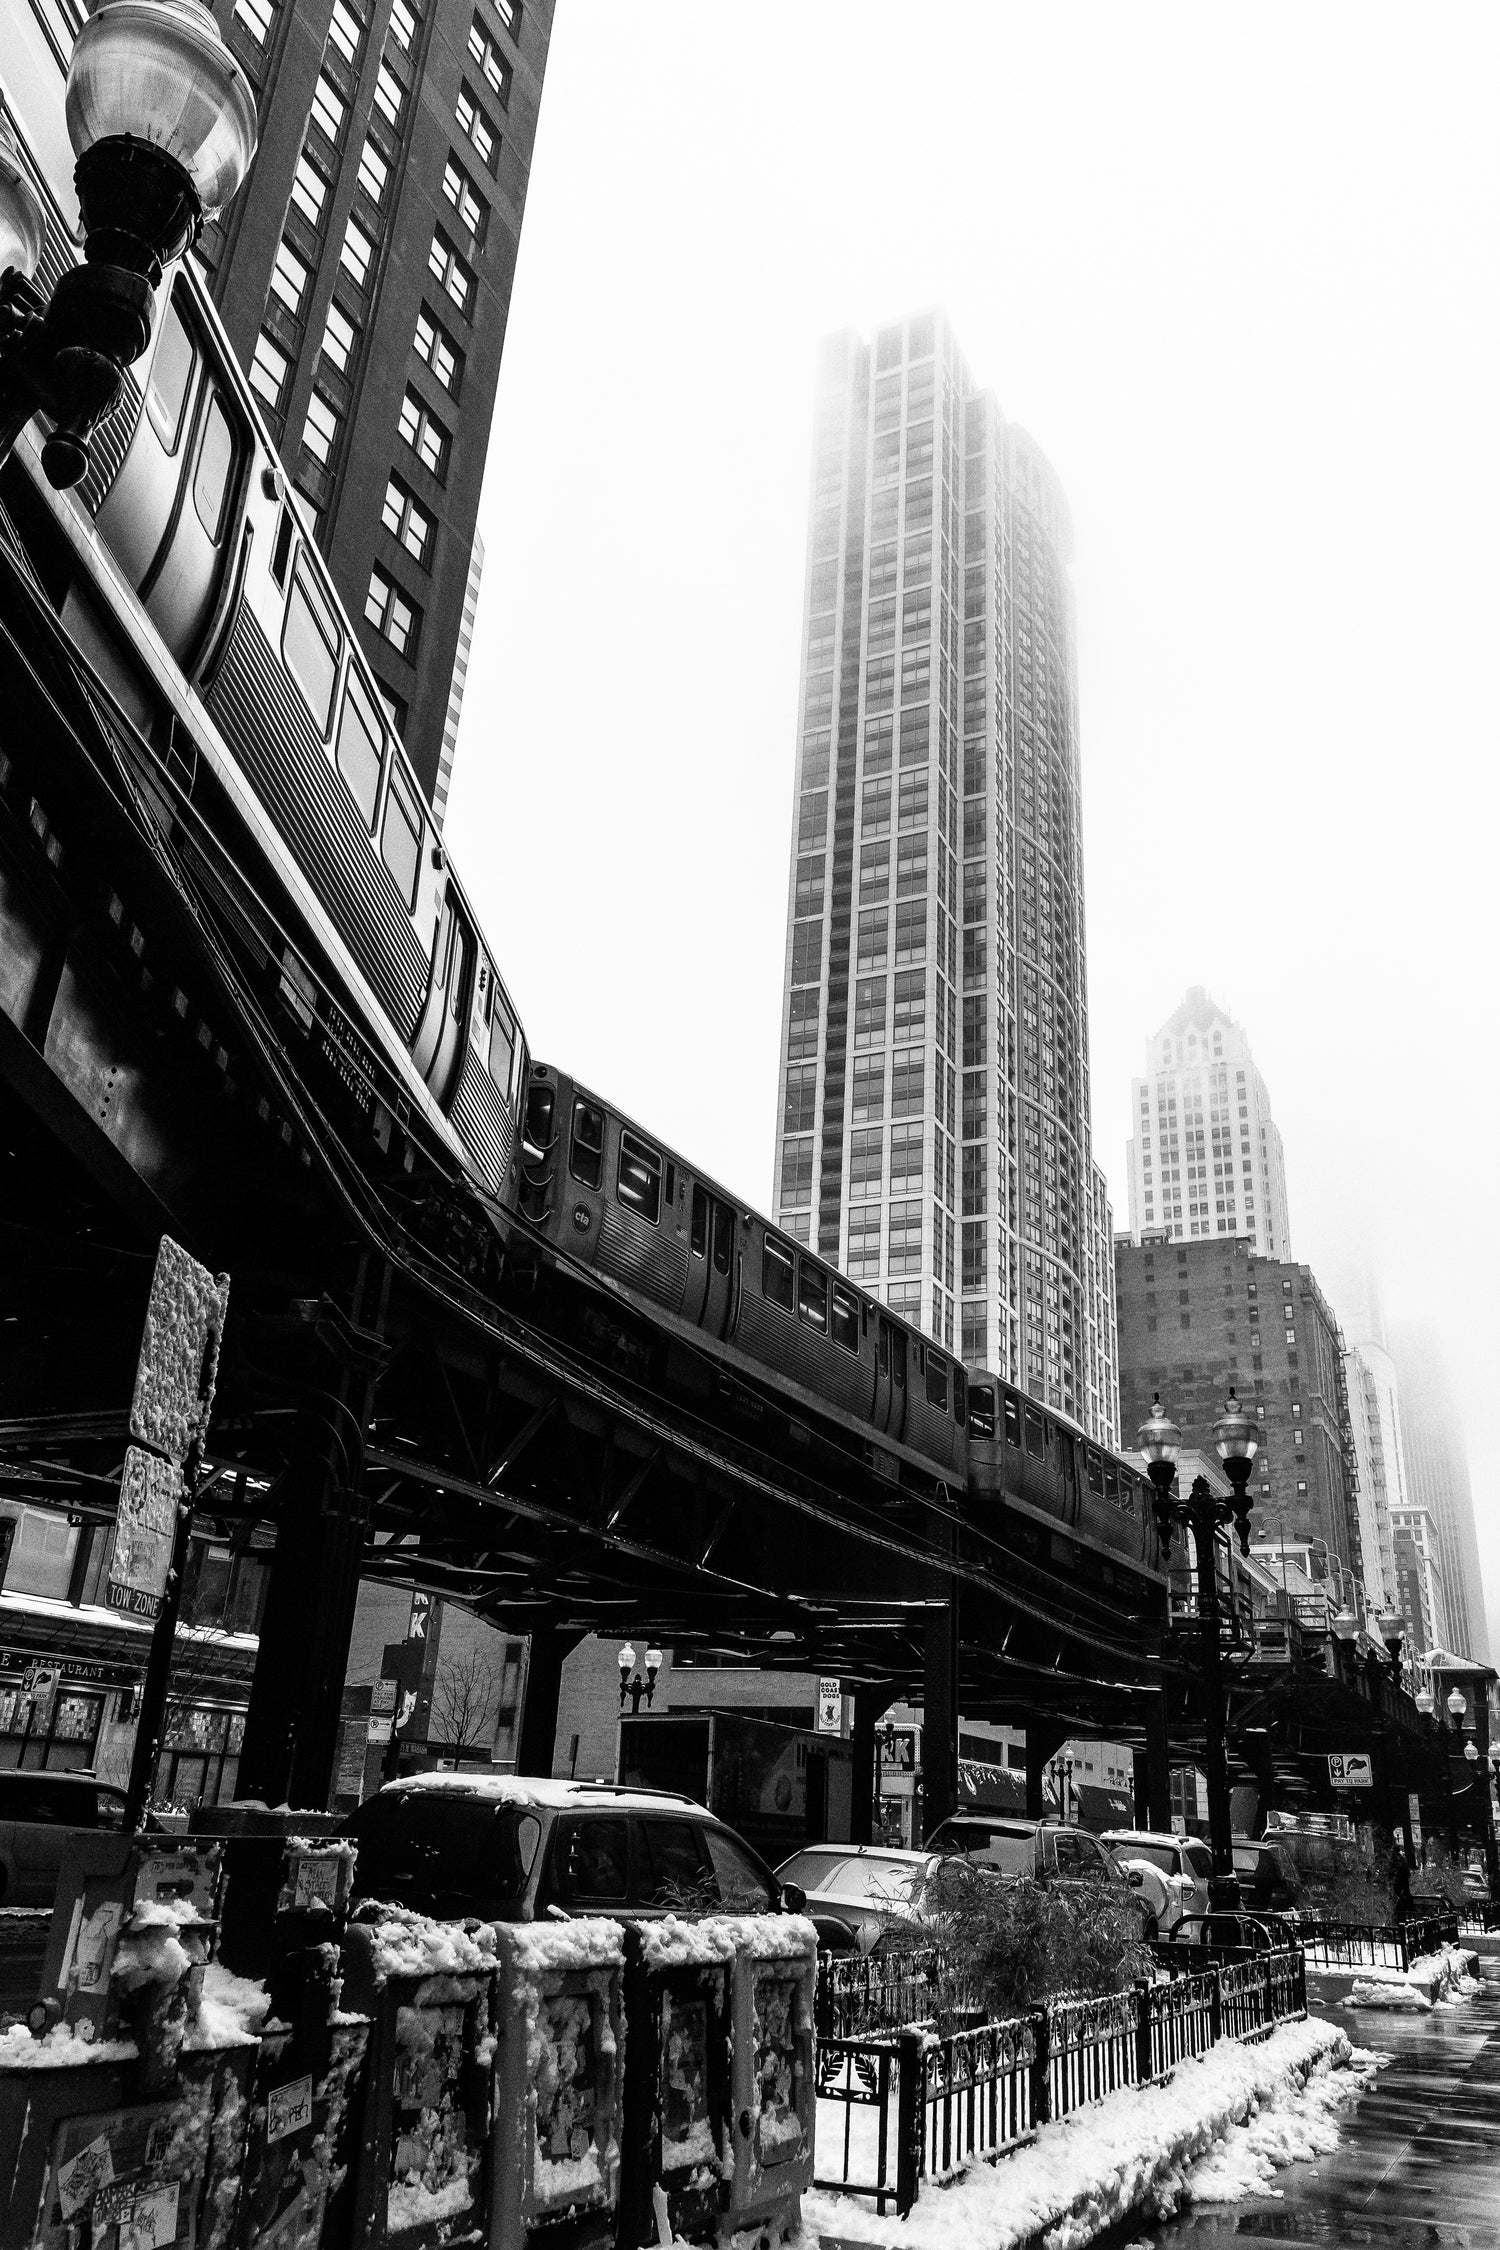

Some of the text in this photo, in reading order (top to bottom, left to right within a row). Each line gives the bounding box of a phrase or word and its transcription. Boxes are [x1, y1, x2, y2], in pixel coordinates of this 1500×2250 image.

[575, 1212, 589, 1226] cta
[111, 1584, 160, 1617] TOW ZONE
[32, 1659, 104, 1678] RESTAURANT
